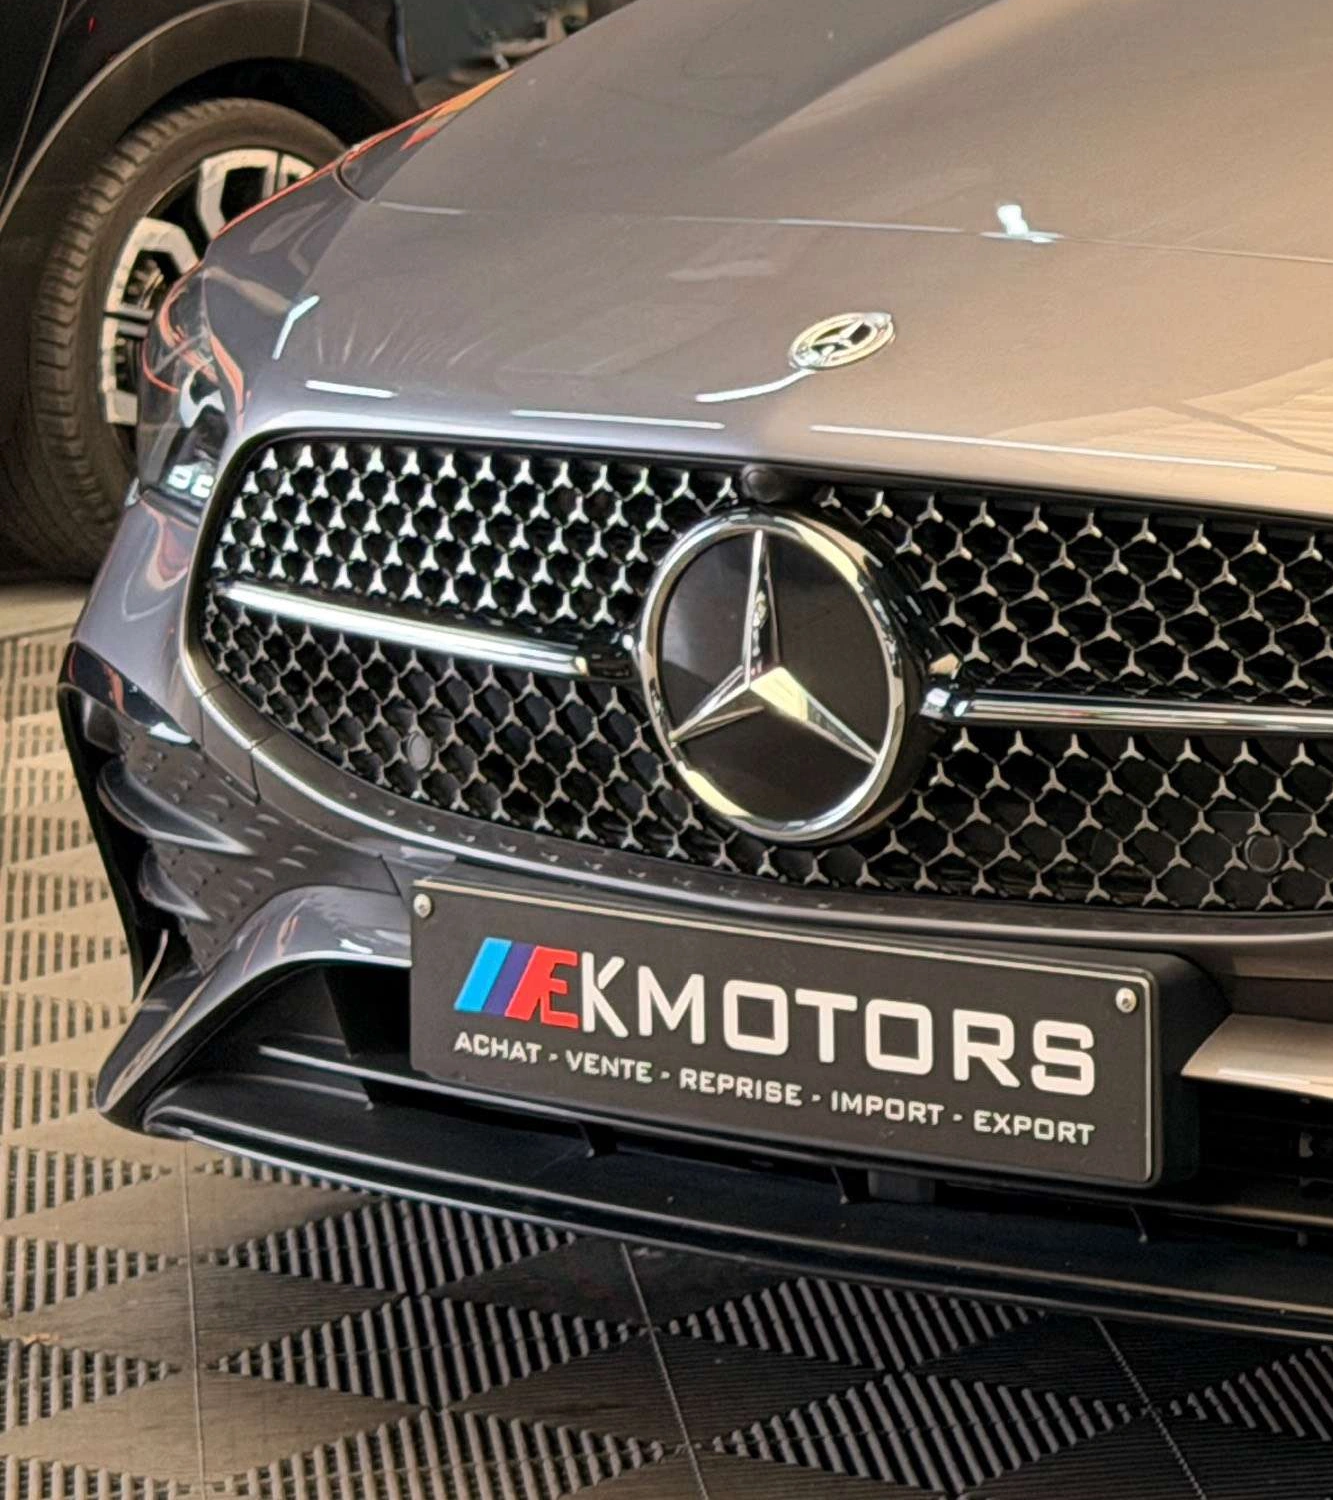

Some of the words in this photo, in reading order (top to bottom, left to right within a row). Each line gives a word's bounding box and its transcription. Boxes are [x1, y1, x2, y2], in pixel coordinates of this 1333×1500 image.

[454, 1031, 542, 1064] ACHAT
[565, 1050, 653, 1083] VENTE
[679, 1067, 802, 1107] REPRISE
[831, 1090, 945, 1125] IMPORT
[973, 1109, 1095, 1145] EXPORT
